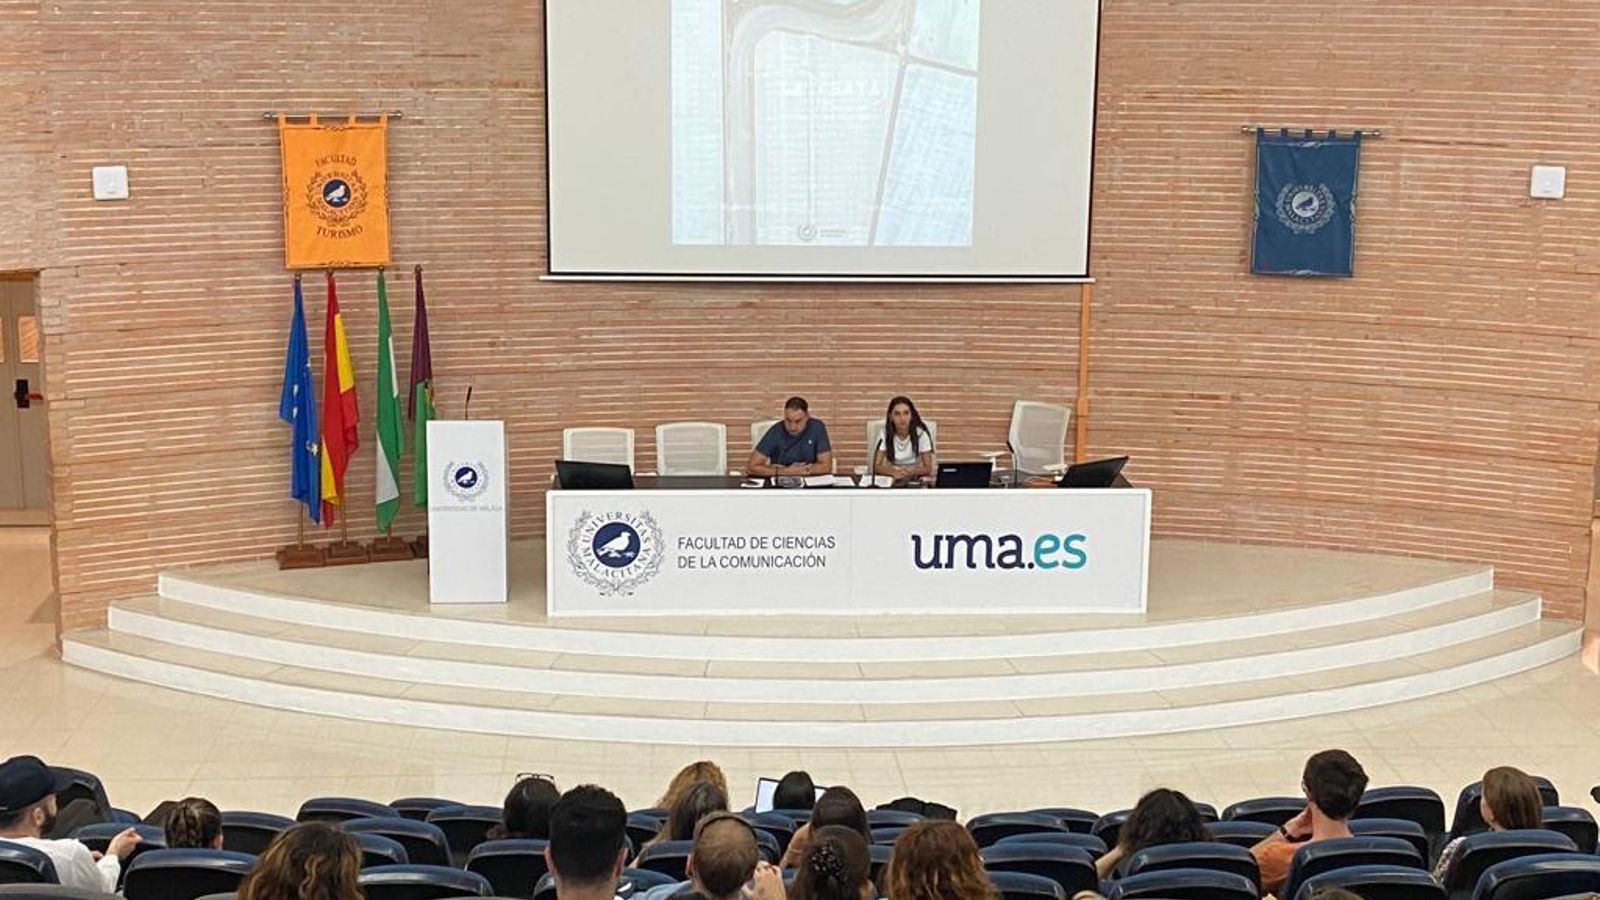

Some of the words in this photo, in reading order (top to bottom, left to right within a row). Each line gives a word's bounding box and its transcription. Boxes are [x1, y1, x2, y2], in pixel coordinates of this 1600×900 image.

[316, 226, 363, 240] TURISMO
[582, 511, 652, 543] UNIVERSITAS
[677, 536, 746, 550] FACULTAD
[750, 536, 769, 549] DE
[773, 535, 836, 550] CIENCIAS
[911, 533, 1088, 570] uma.es
[582, 547, 652, 577] MALACITANA
[677, 555, 694, 569] DE
[697, 555, 717, 569] LA
[719, 551, 826, 569] COMUNICACIÓN
